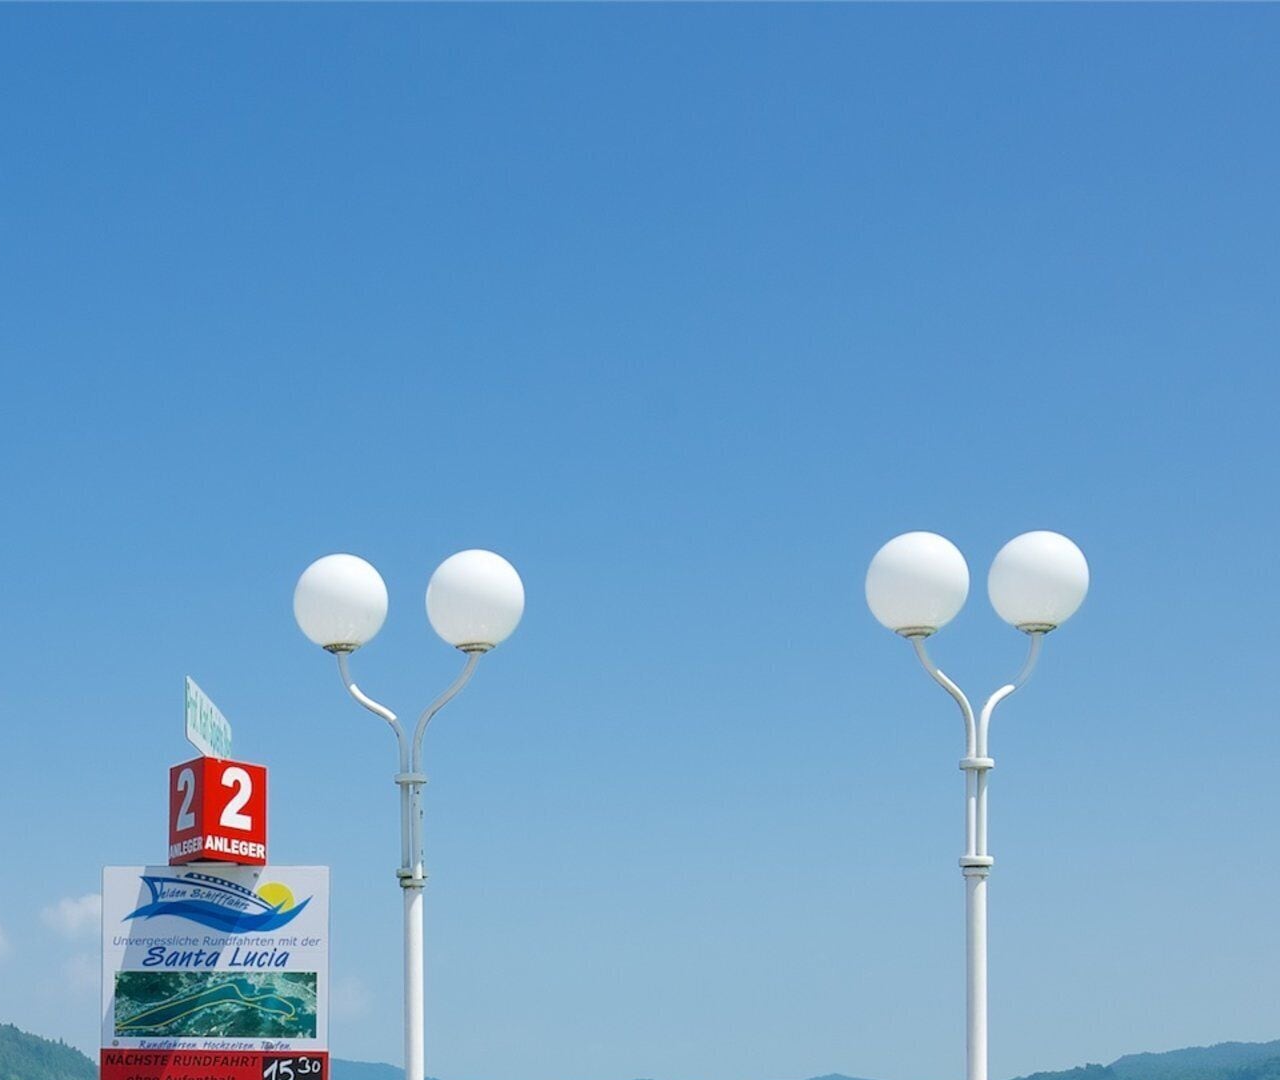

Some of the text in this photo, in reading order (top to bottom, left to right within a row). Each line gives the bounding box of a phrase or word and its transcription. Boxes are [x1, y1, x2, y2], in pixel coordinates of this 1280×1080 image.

[176, 768, 195, 832] 2
[219, 766, 253, 832] 2
[170, 836, 203, 859] ANLEGER
[205, 834, 266, 859] ANLEGER
[113, 935, 321, 948] Unvergessliche Rundfahrten mit der
[142, 946, 290, 968] Santa Lucia
[173, 1055, 259, 1068] RUNDFAHRT
